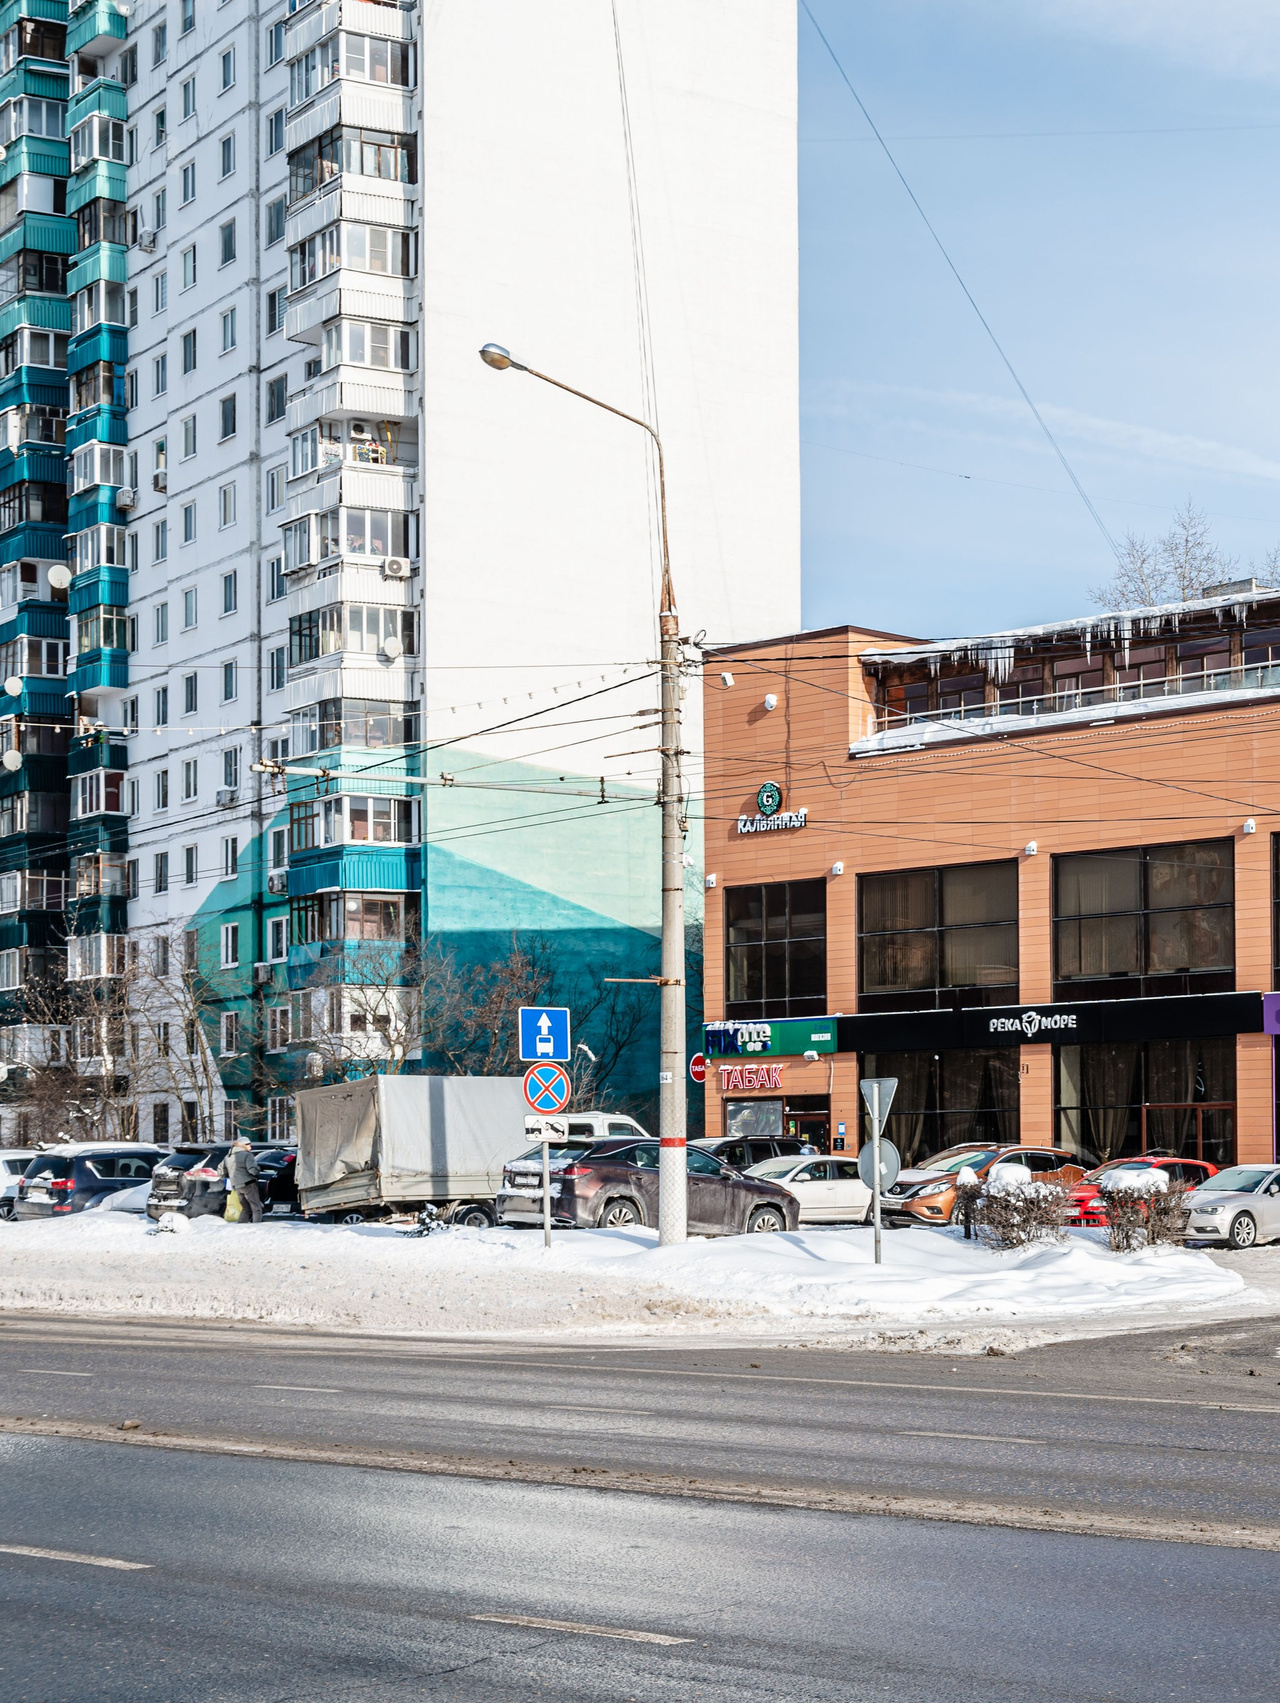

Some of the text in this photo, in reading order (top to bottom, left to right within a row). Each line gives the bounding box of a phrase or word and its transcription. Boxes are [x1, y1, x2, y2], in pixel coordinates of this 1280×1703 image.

[763, 792, 773, 805] G
[989, 1014, 1077, 1032] РЕКА МОРЕ
[719, 1065, 784, 1089] ТАБАК
